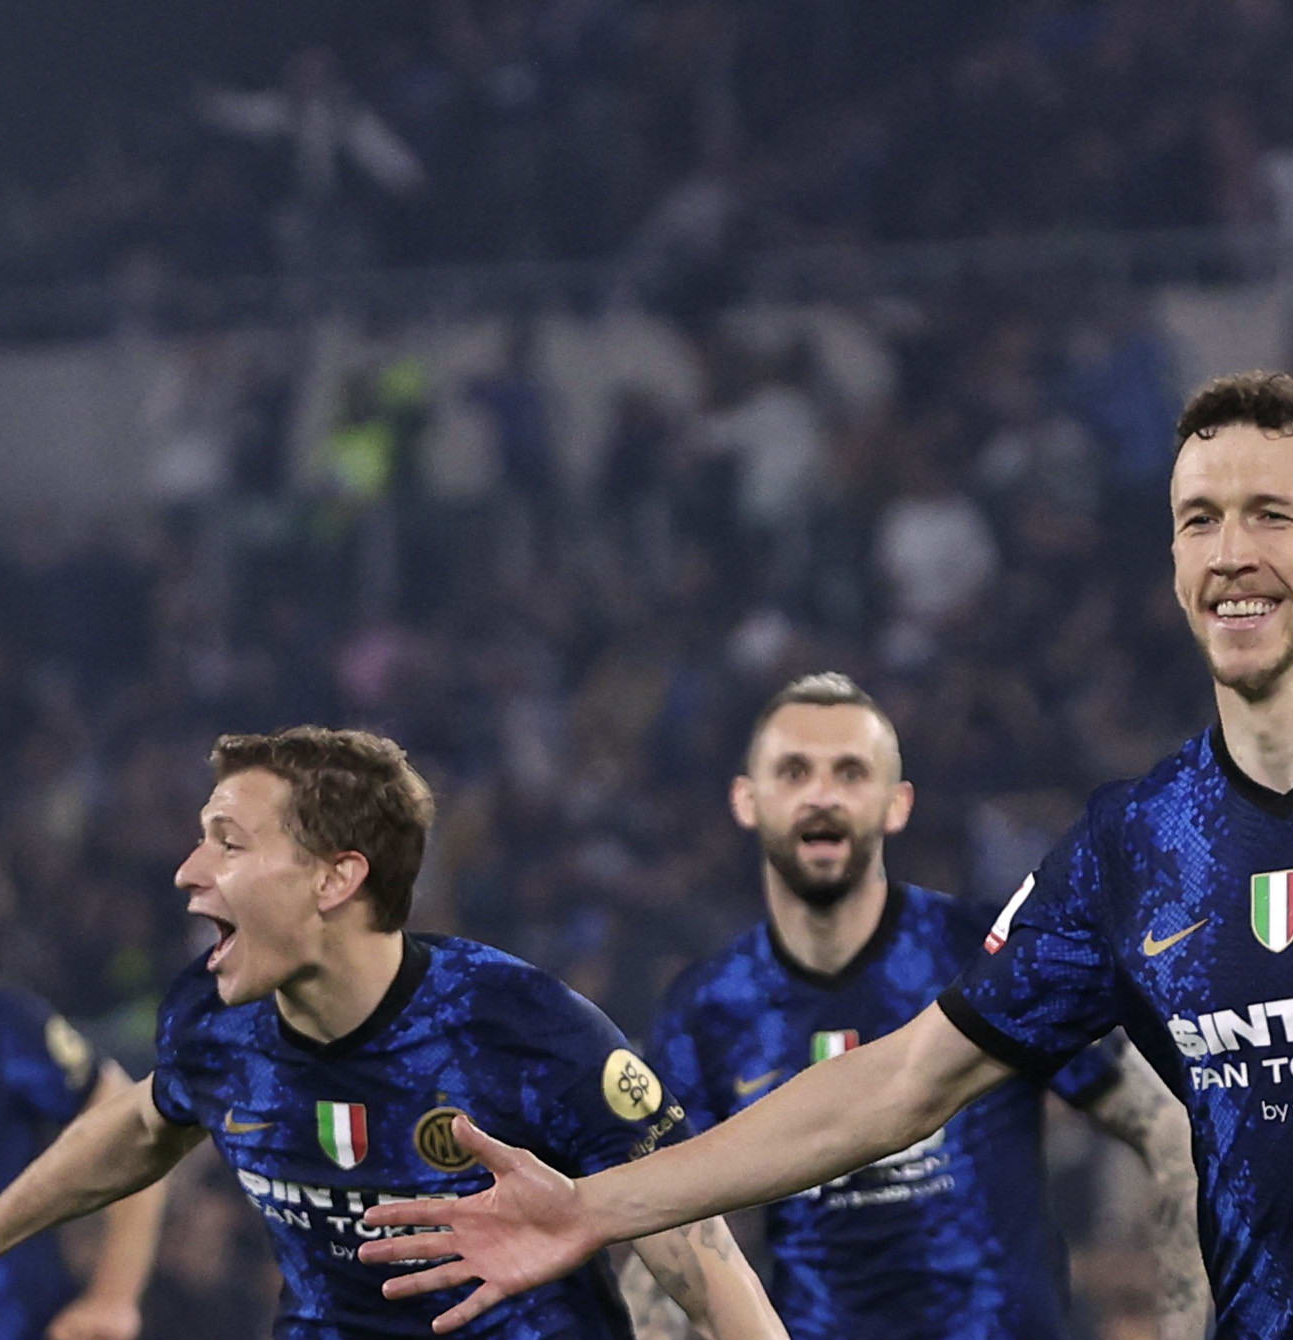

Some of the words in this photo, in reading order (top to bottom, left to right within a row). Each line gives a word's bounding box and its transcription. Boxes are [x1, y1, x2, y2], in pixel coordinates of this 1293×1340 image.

[1190, 1062, 1249, 1090] FAN
[1262, 1101, 1288, 1122] by
[330, 1241, 355, 1261] by
